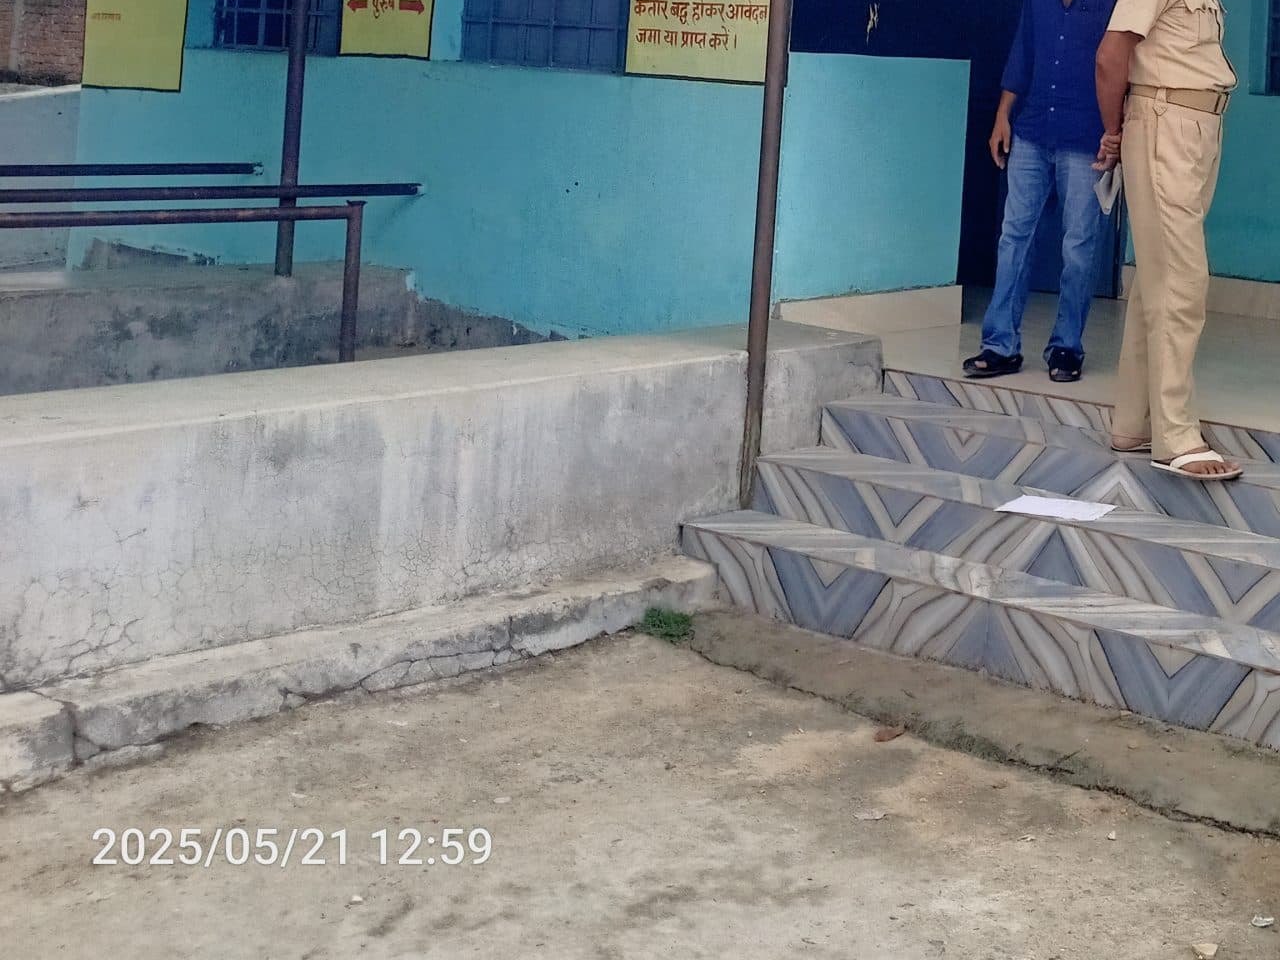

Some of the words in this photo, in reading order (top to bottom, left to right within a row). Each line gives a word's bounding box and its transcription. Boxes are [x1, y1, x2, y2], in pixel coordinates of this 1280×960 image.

[634, 0, 668, 20] कतार
[663, 30, 678, 47] या
[680, 31, 706, 49] प्राप्त
